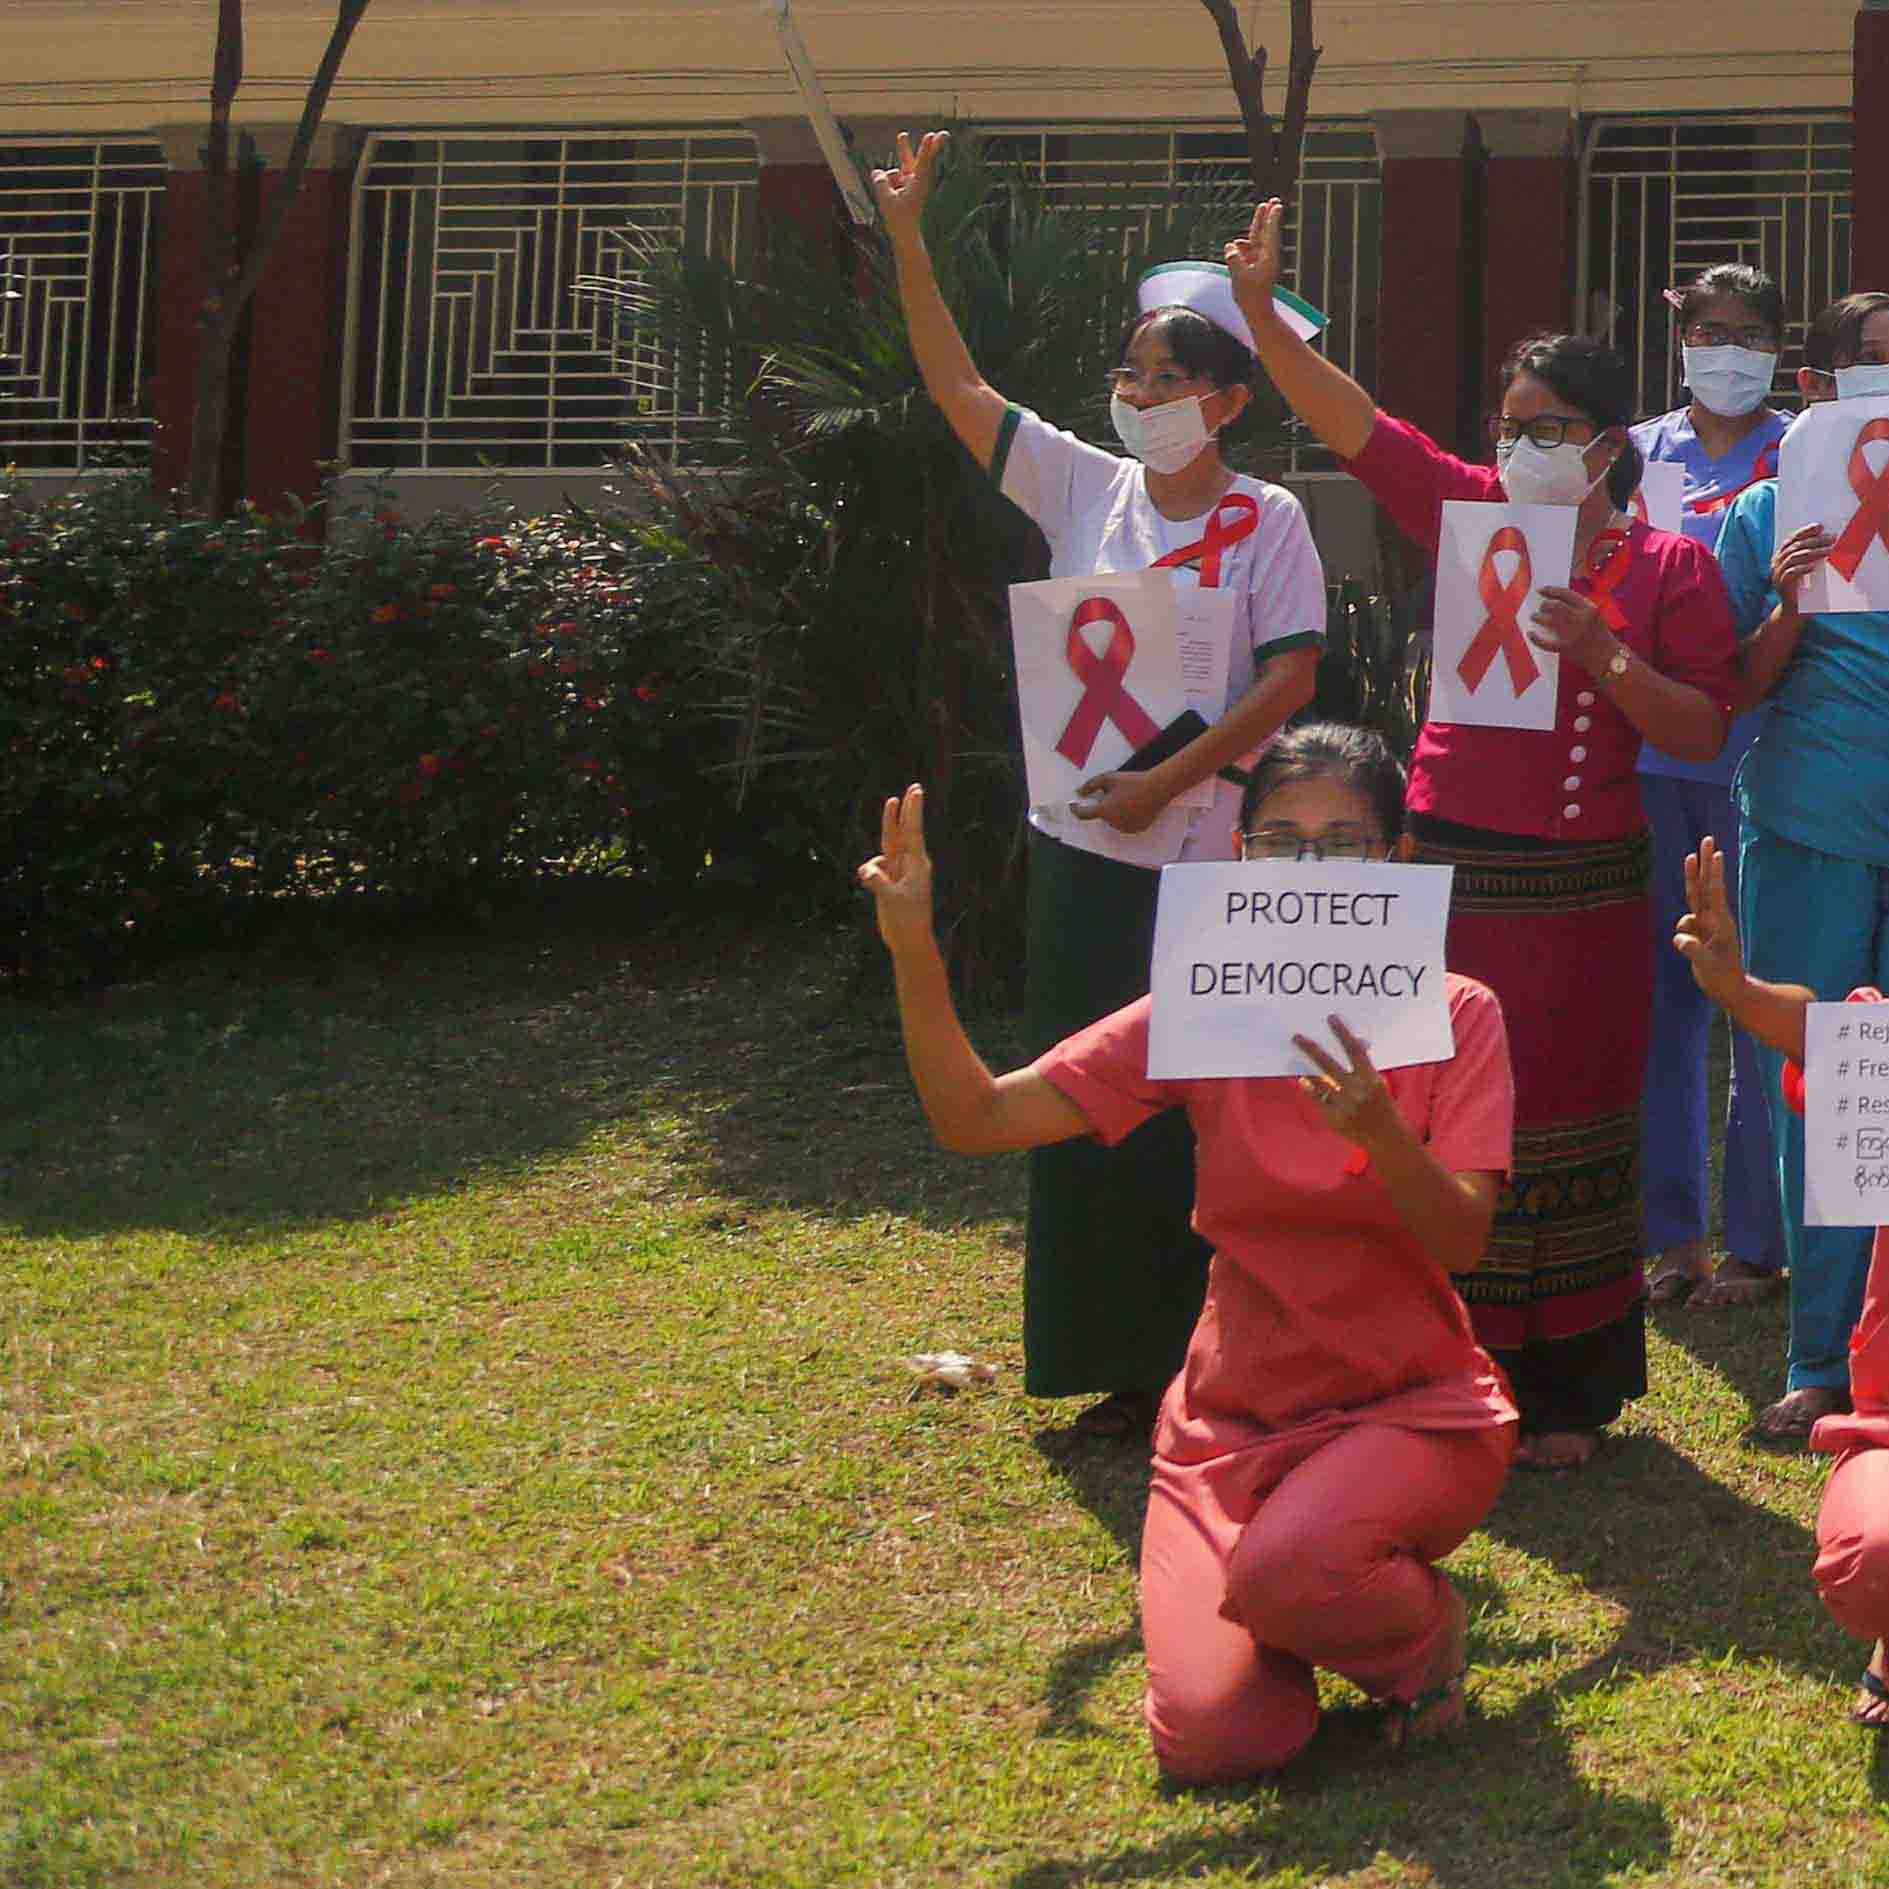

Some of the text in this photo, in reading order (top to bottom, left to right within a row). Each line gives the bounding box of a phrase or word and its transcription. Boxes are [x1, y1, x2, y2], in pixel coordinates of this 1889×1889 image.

[1225, 891, 1400, 927] PROTECT
[1190, 961, 1427, 998] DEMOCRACY
[1837, 1023, 1850, 1041] #
[1837, 1060, 1849, 1077] #
[1837, 1096, 1849, 1113] #
[1836, 1134, 1848, 1151] #
